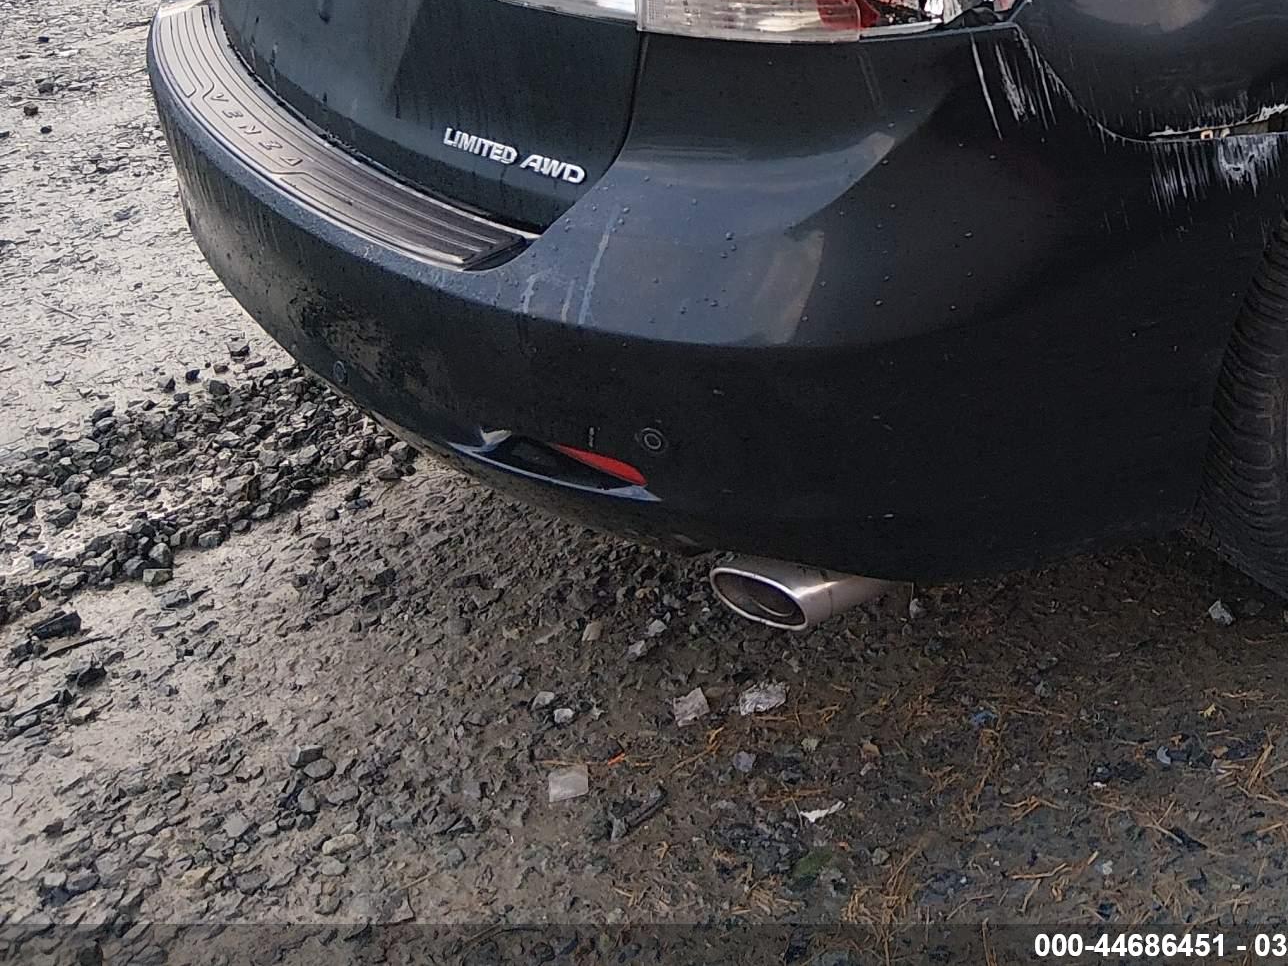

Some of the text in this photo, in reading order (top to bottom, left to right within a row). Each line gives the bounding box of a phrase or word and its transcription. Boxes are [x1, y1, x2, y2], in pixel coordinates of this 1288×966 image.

[209, 92, 304, 167] VENZA
[443, 127, 587, 184] LIMITED AWD
